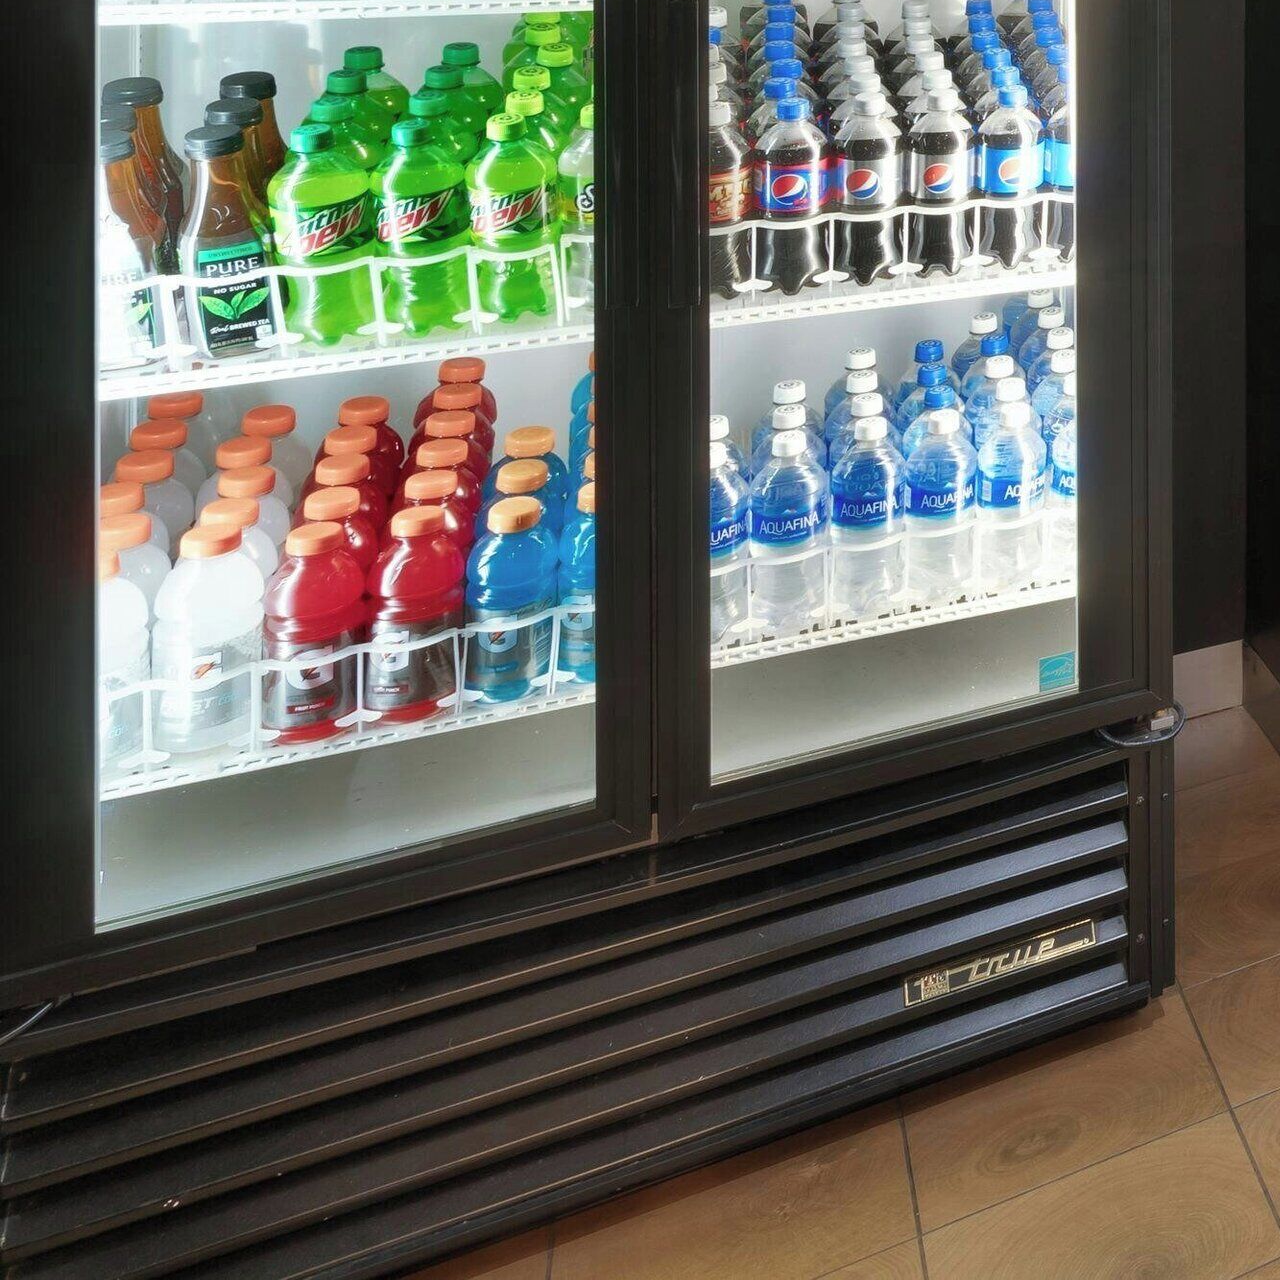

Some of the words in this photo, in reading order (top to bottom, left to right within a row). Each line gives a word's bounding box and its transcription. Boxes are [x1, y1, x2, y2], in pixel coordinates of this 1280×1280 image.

[206, 256, 260, 277] PURE
[213, 287, 228, 295] NO
[229, 282, 257, 293] SUGAR
[258, 318, 271, 328] TEA
[840, 495, 900, 520] AQUAFINA
[920, 484, 974, 510] AQUAFINA
[759, 511, 820, 537] AQUAFINA
